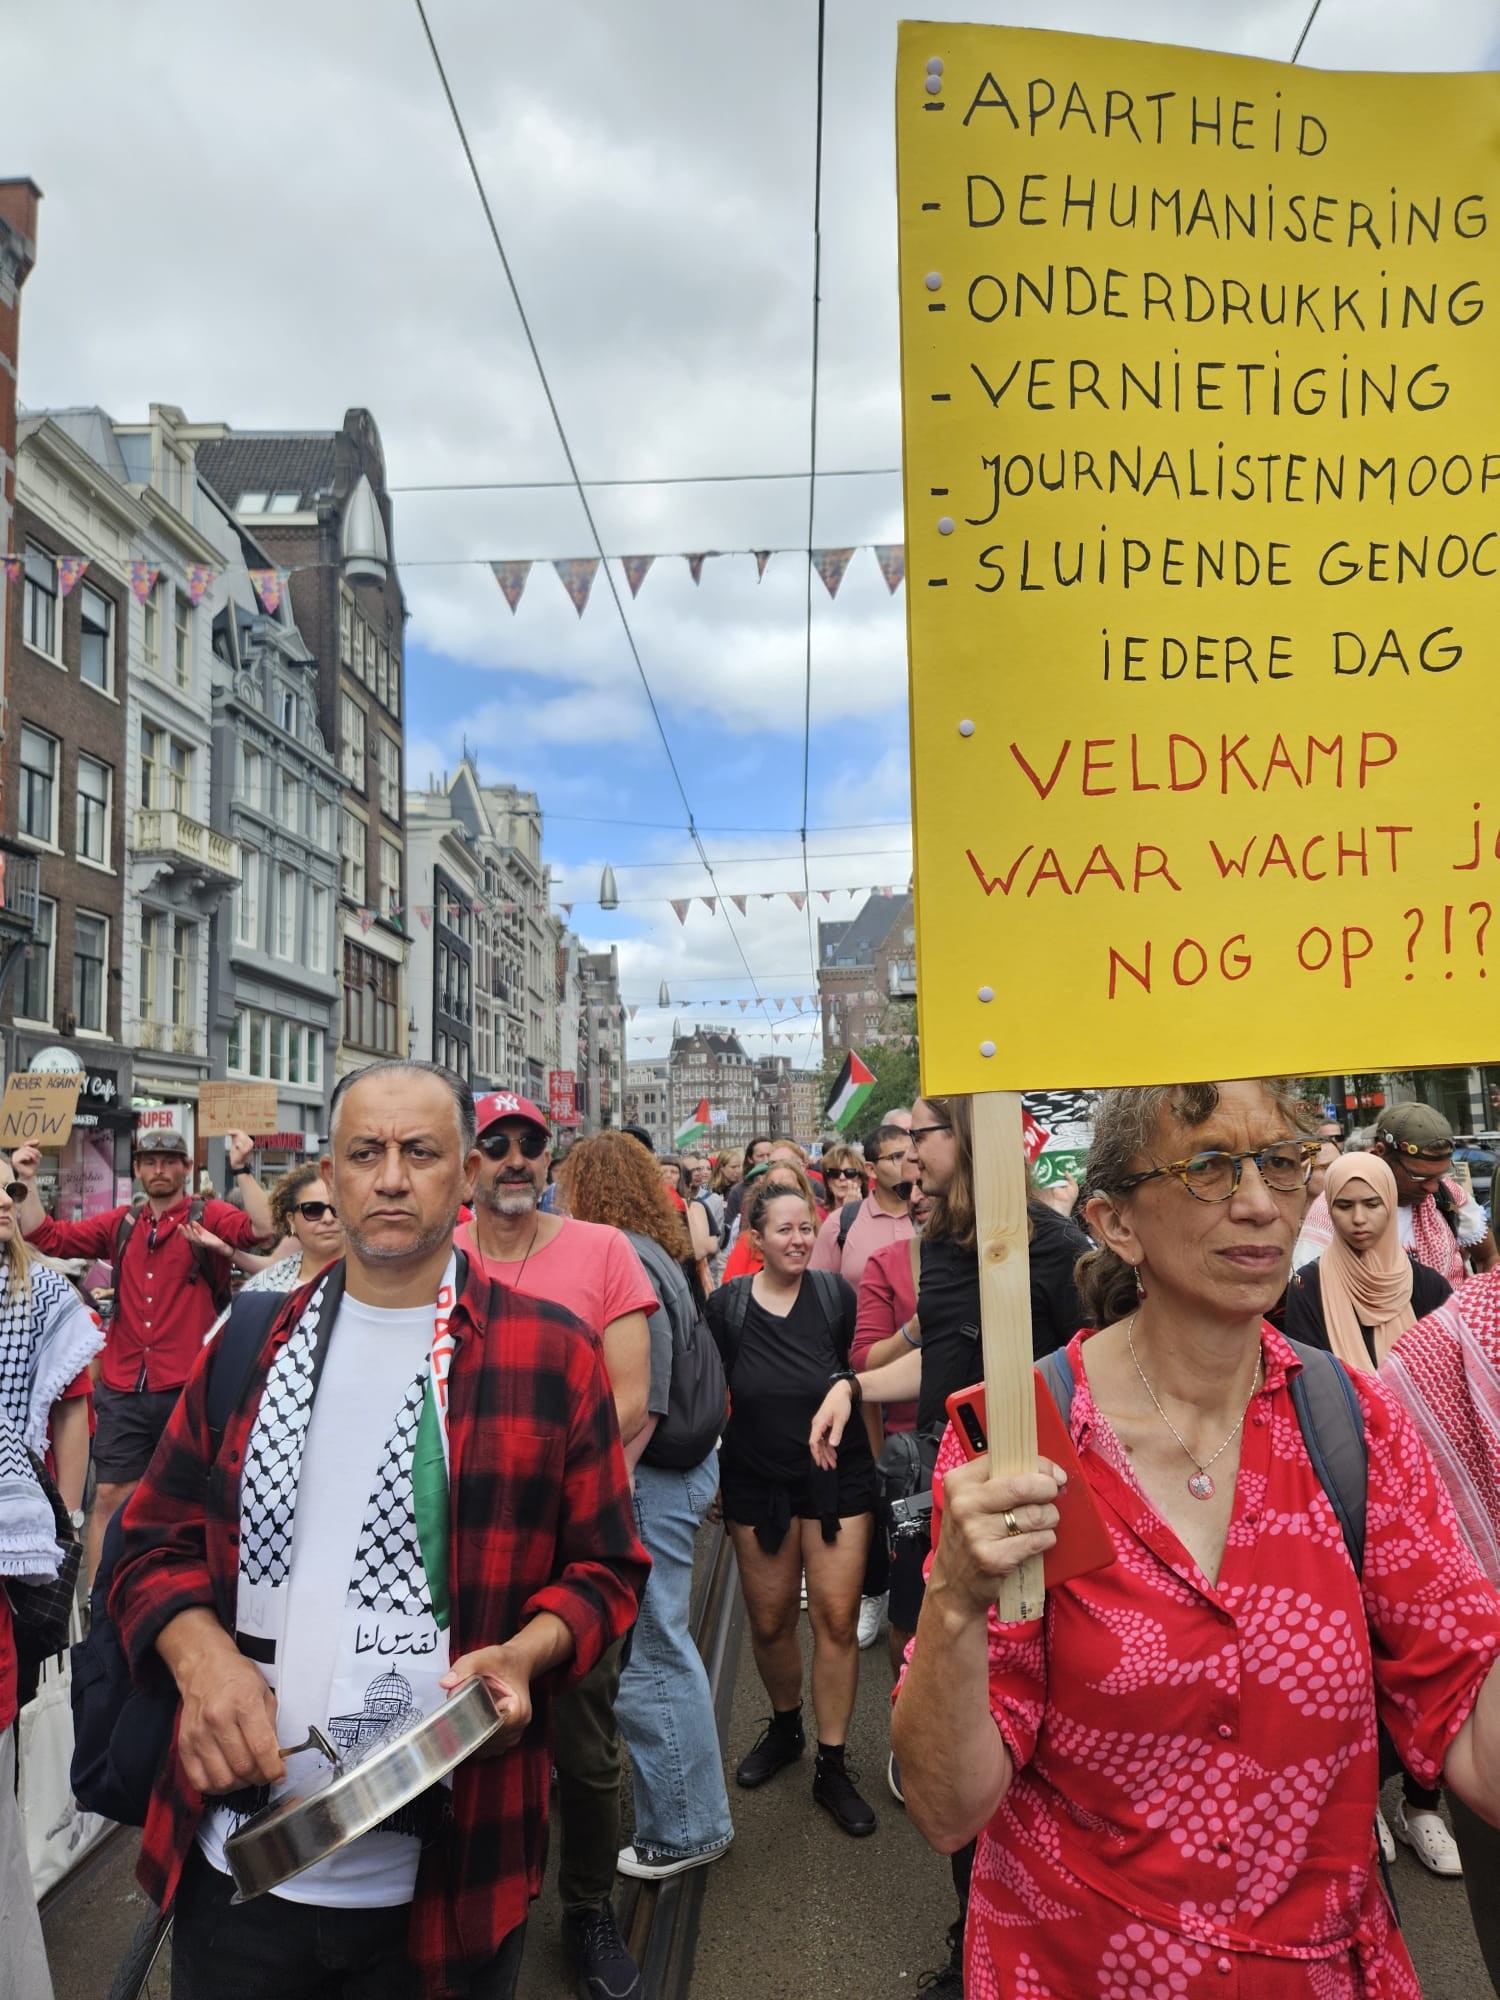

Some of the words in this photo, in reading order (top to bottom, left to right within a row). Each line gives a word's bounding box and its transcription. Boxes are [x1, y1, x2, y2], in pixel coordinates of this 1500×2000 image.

[1332, 626, 1463, 677] DAG
[1010, 732, 1398, 800] VELDKAMP
[966, 844, 1181, 897] WAAR
[1209, 827, 1412, 882] WACHT
[1108, 934, 1253, 999] NOG
[1297, 926, 1374, 989] OP
[11, 1077, 42, 1090] NEVER
[47, 1077, 78, 1090] AGAIN
[92, 1077, 117, 1103] Cafe
[3, 1110, 66, 1137] NOW
[355, 1623, 380, 1654] لنا
